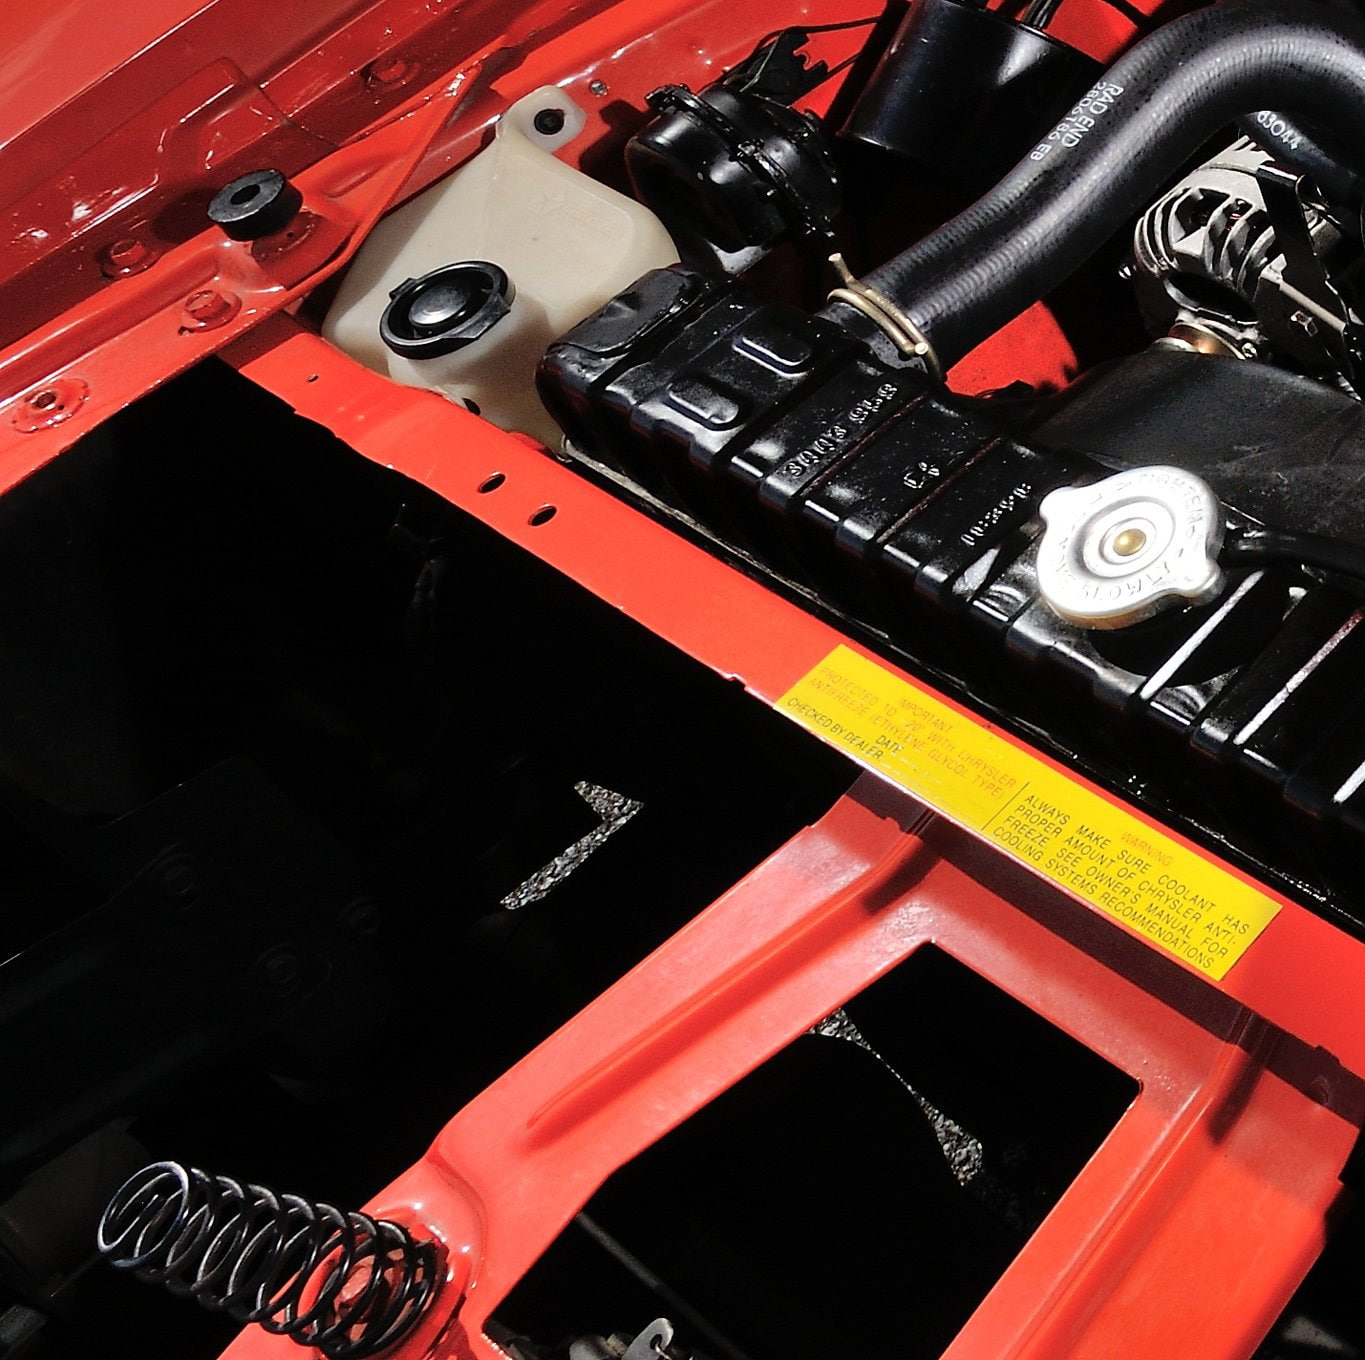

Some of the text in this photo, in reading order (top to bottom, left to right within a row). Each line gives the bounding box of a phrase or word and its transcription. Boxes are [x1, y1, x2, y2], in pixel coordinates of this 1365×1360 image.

[1061, 83, 1124, 148] RAD END
[1256, 110, 1302, 150] 63044
[787, 697, 885, 761] CHECKED BY DEALER
[807, 676, 870, 722] ANTIFREEZE
[819, 666, 879, 706] PROTECTED
[927, 732, 956, 753] WITH
[957, 750, 1018, 789] CHRYSLER
[993, 826, 1046, 863] COOLING
[1045, 859, 1098, 896] SYSTEMS
[1014, 804, 1063, 838] PROPER
[1064, 836, 1115, 870] AMOUNT
[1117, 866, 1138, 886] OF
[1138, 880, 1203, 923] CHRYSLER
[1024, 793, 1250, 936] ALWAYS MAKE SURE COOLANT HAS
[1120, 831, 1174, 868] WARNING
[1056, 847, 1083, 868] SEE
[1086, 866, 1140, 905] OWNER'S
[1145, 902, 1193, 940] MANUAL
[1201, 936, 1230, 960] FOR
